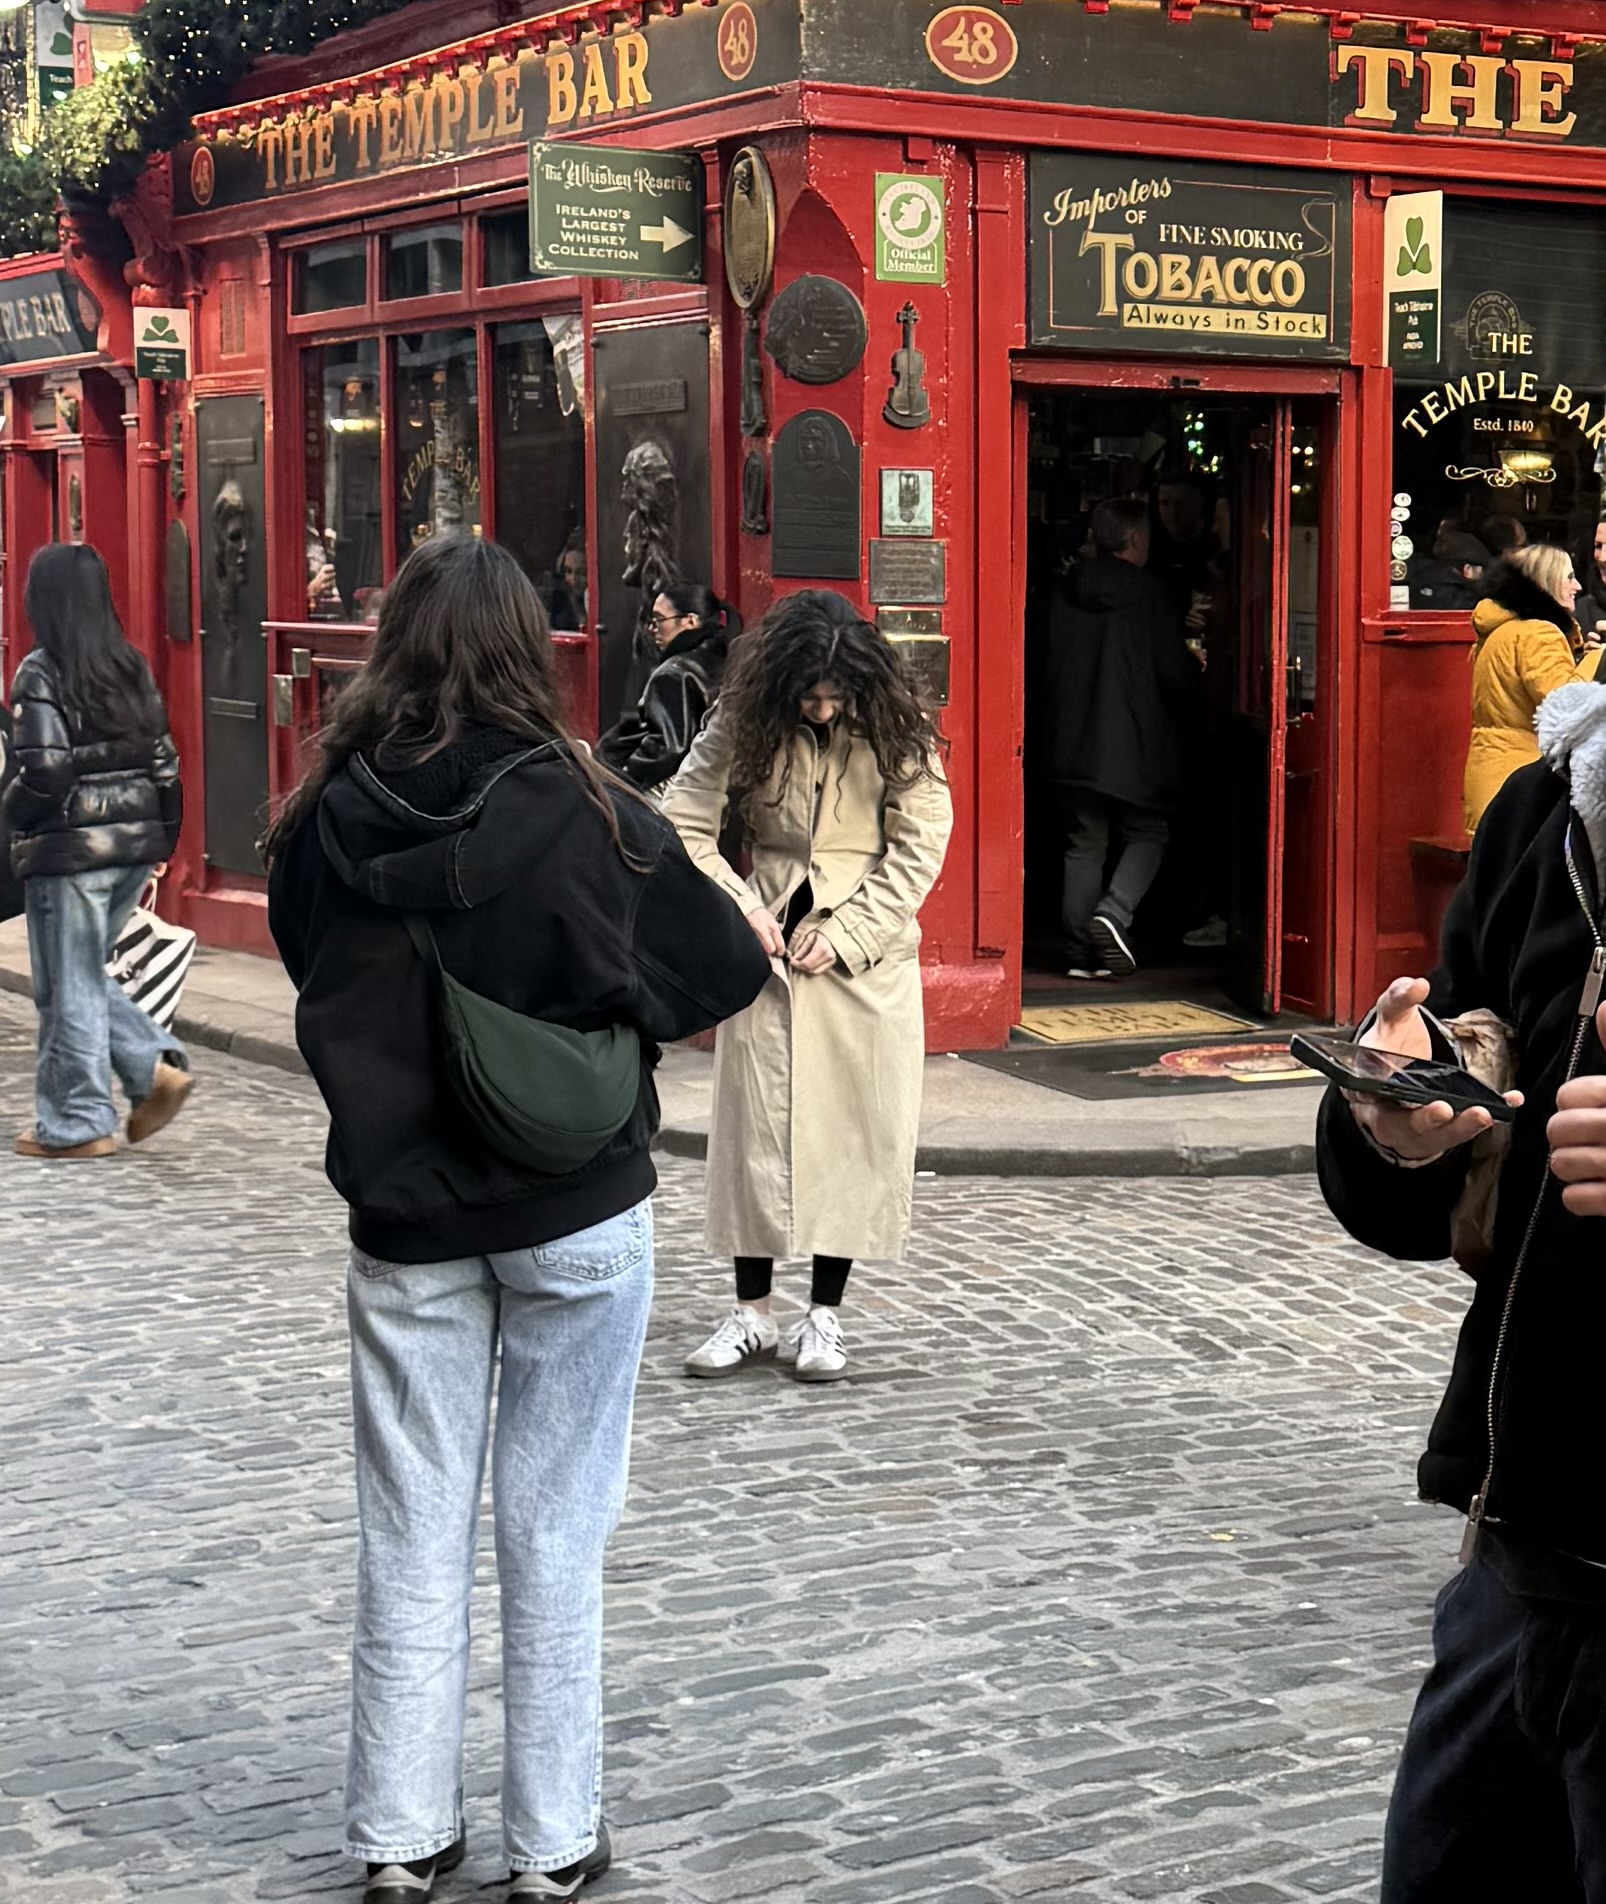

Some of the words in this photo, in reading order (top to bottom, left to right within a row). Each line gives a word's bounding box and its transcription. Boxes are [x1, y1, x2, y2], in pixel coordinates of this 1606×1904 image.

[725, 19, 751, 65] 48
[941, 17, 999, 65] 48
[1332, 45, 1578, 139] THE
[257, 114, 337, 190] THE
[349, 65, 525, 169] TEMPLE
[545, 31, 653, 126] BAR
[541, 163, 563, 181] The
[561, 159, 633, 193] Whiskey
[634, 167, 693, 198] Reserve
[556, 203, 632, 220] IRELAND'S
[1043, 175, 1172, 231] Importers
[1125, 209, 1148, 225] OF
[560, 230, 628, 246] WHISKEY
[561, 217, 627, 233] LARGEST
[1158, 223, 1207, 246] FINE
[1209, 227, 1304, 252] SMOKING
[548, 243, 640, 261] COLLECTION
[890, 247, 932, 261] Official
[1077, 229, 1306, 317] TOBACCO
[0, 299, 33, 342] PLE
[30, 290, 72, 336] BAR
[1126, 303, 1212, 330] Always
[1226, 312, 1246, 330] in
[1255, 311, 1323, 336] Stock
[1487, 331, 1534, 355] THE
[1401, 370, 1540, 439] TEMPLE
[1473, 417, 1504, 432] Estd.
